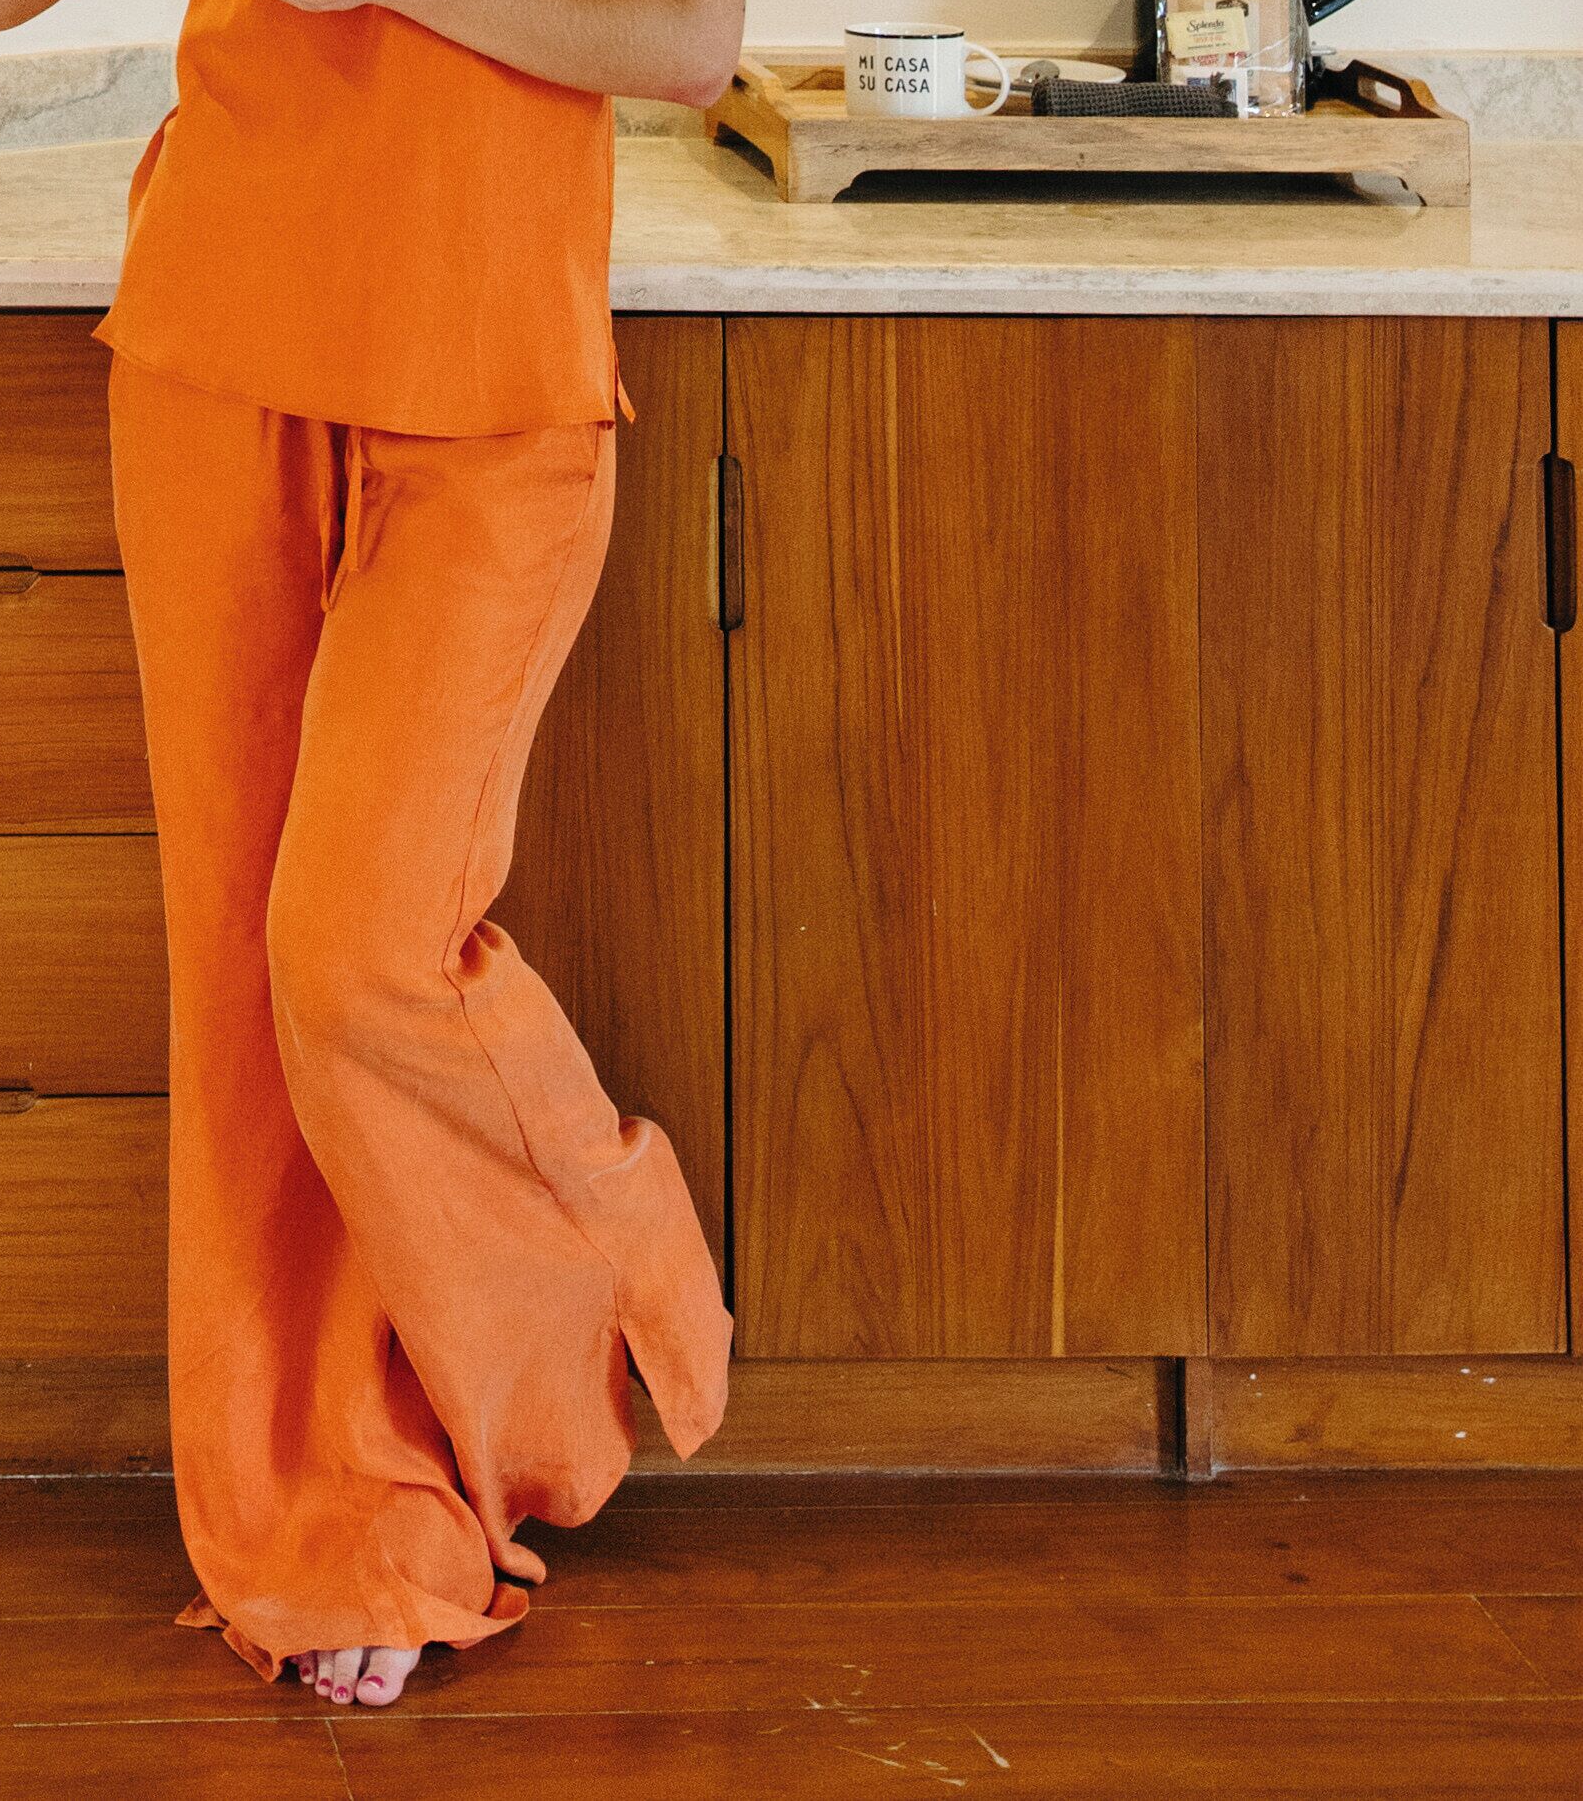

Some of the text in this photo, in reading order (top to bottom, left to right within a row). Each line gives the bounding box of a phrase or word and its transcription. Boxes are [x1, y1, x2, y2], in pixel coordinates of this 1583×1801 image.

[859, 55, 930, 73] MI CASA
[859, 74, 931, 94] SU CASA
